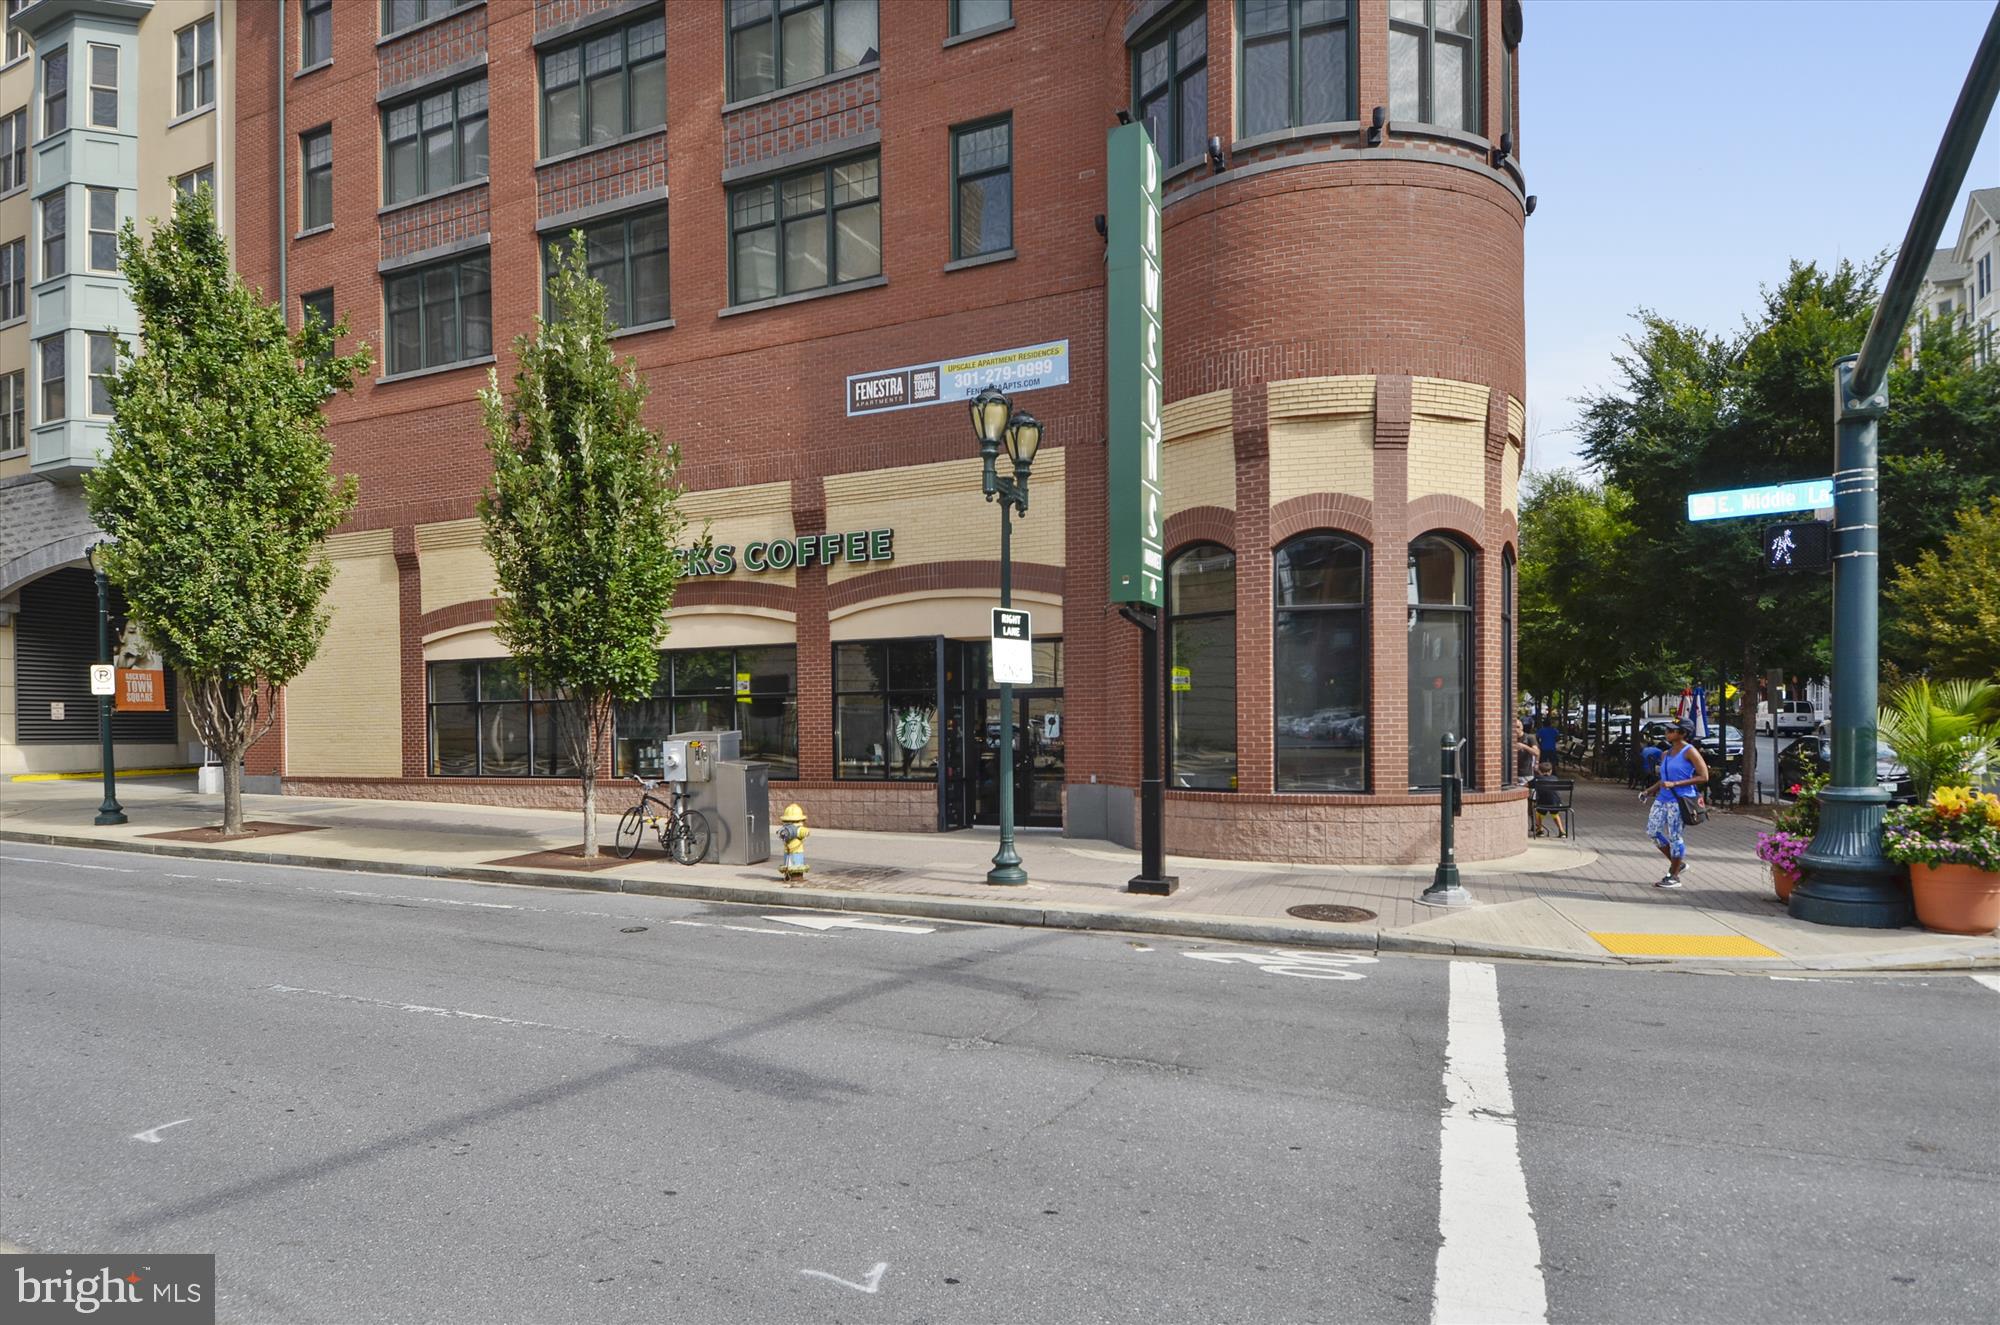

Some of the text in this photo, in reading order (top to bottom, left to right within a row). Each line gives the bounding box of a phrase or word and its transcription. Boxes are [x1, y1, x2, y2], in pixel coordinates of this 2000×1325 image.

[947, 347, 1060, 372] UPSCALE APARTMENT RESIDENCES
[954, 359, 1053, 388] 301-279-0999
[855, 377, 904, 401] FENESTRA
[913, 378, 936, 391] TOWN
[914, 388, 936, 399] SQUARE
[856, 395, 903, 407] APARTMENTS
[1742, 490, 1796, 511] Middle
[743, 528, 893, 572] COFFEE
[1001, 613, 1021, 625] RIGHT
[1002, 626, 1021, 637] LANE
[125, 672, 152, 681] ROCKVILLE
[125, 680, 153, 693] TOWN
[126, 692, 154, 703] SQUARE
